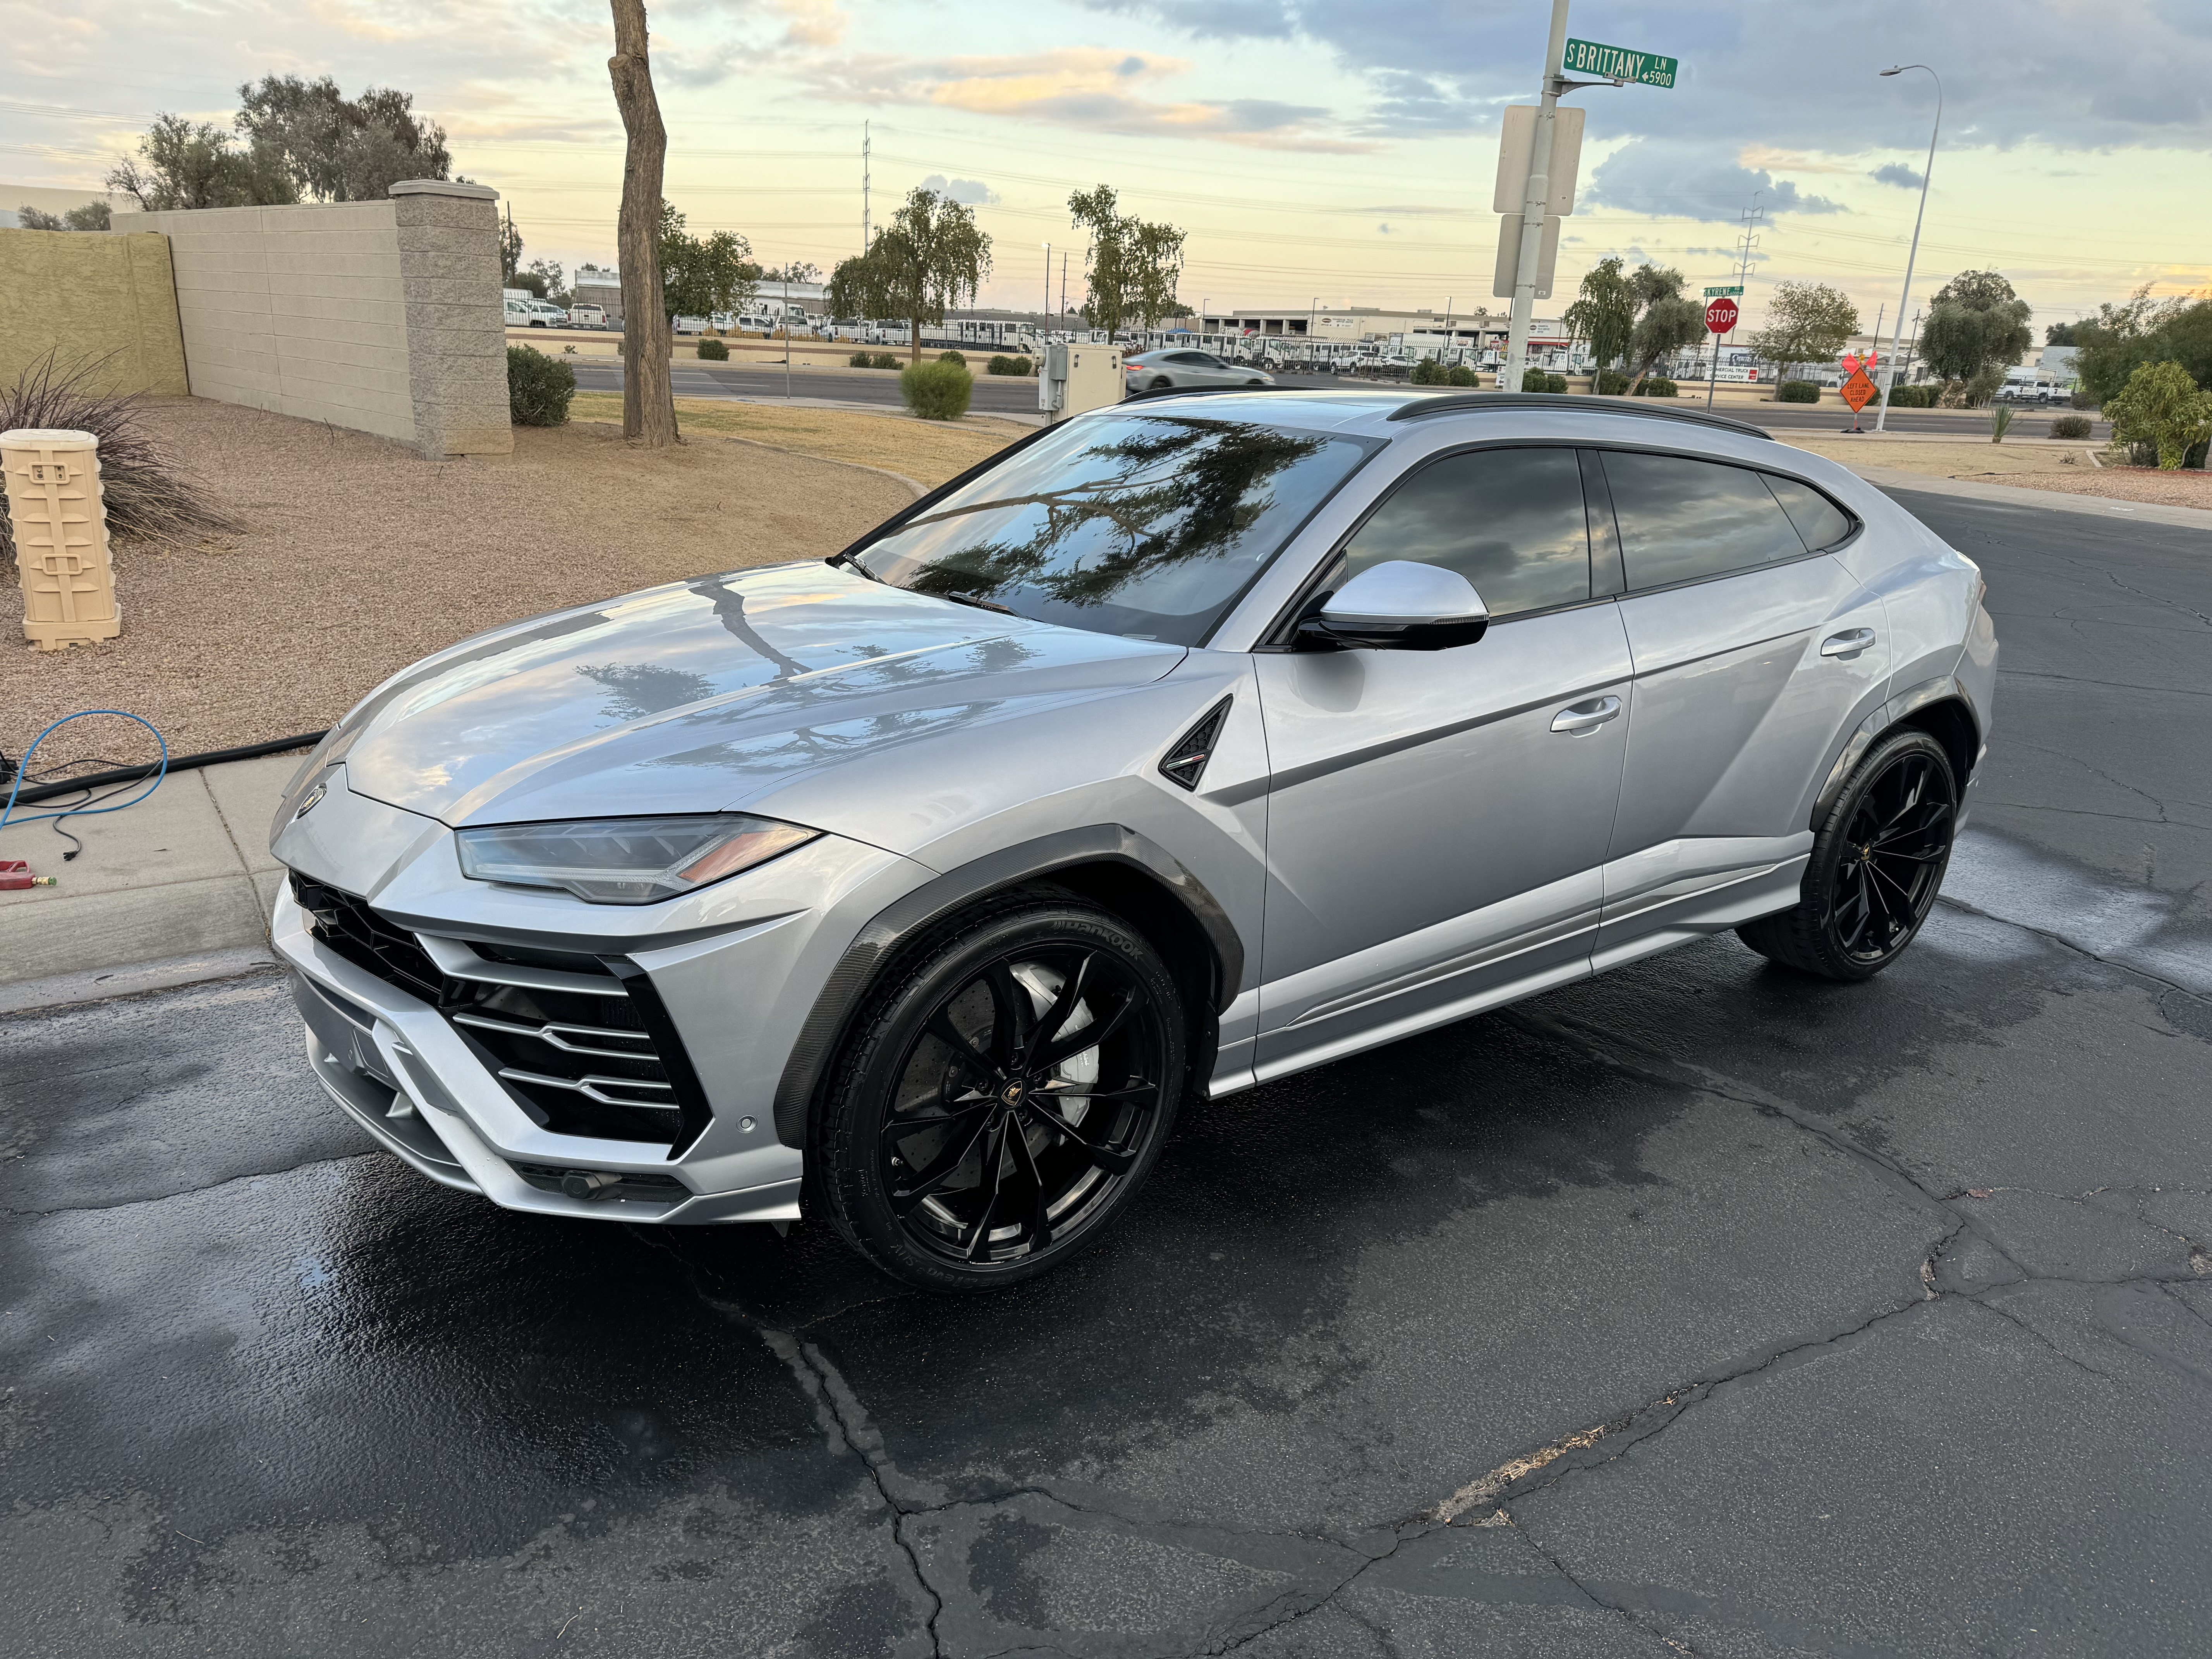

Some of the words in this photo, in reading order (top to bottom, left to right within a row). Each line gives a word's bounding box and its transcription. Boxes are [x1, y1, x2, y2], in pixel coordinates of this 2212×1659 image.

[1567, 43, 1575, 63] S
[1577, 44, 1645, 79] BRITTANY
[1655, 57, 1667, 70] LN
[1649, 71, 1672, 86] 5900
[1707, 287, 1730, 296] KYRENE
[1707, 309, 1736, 323] STOP
